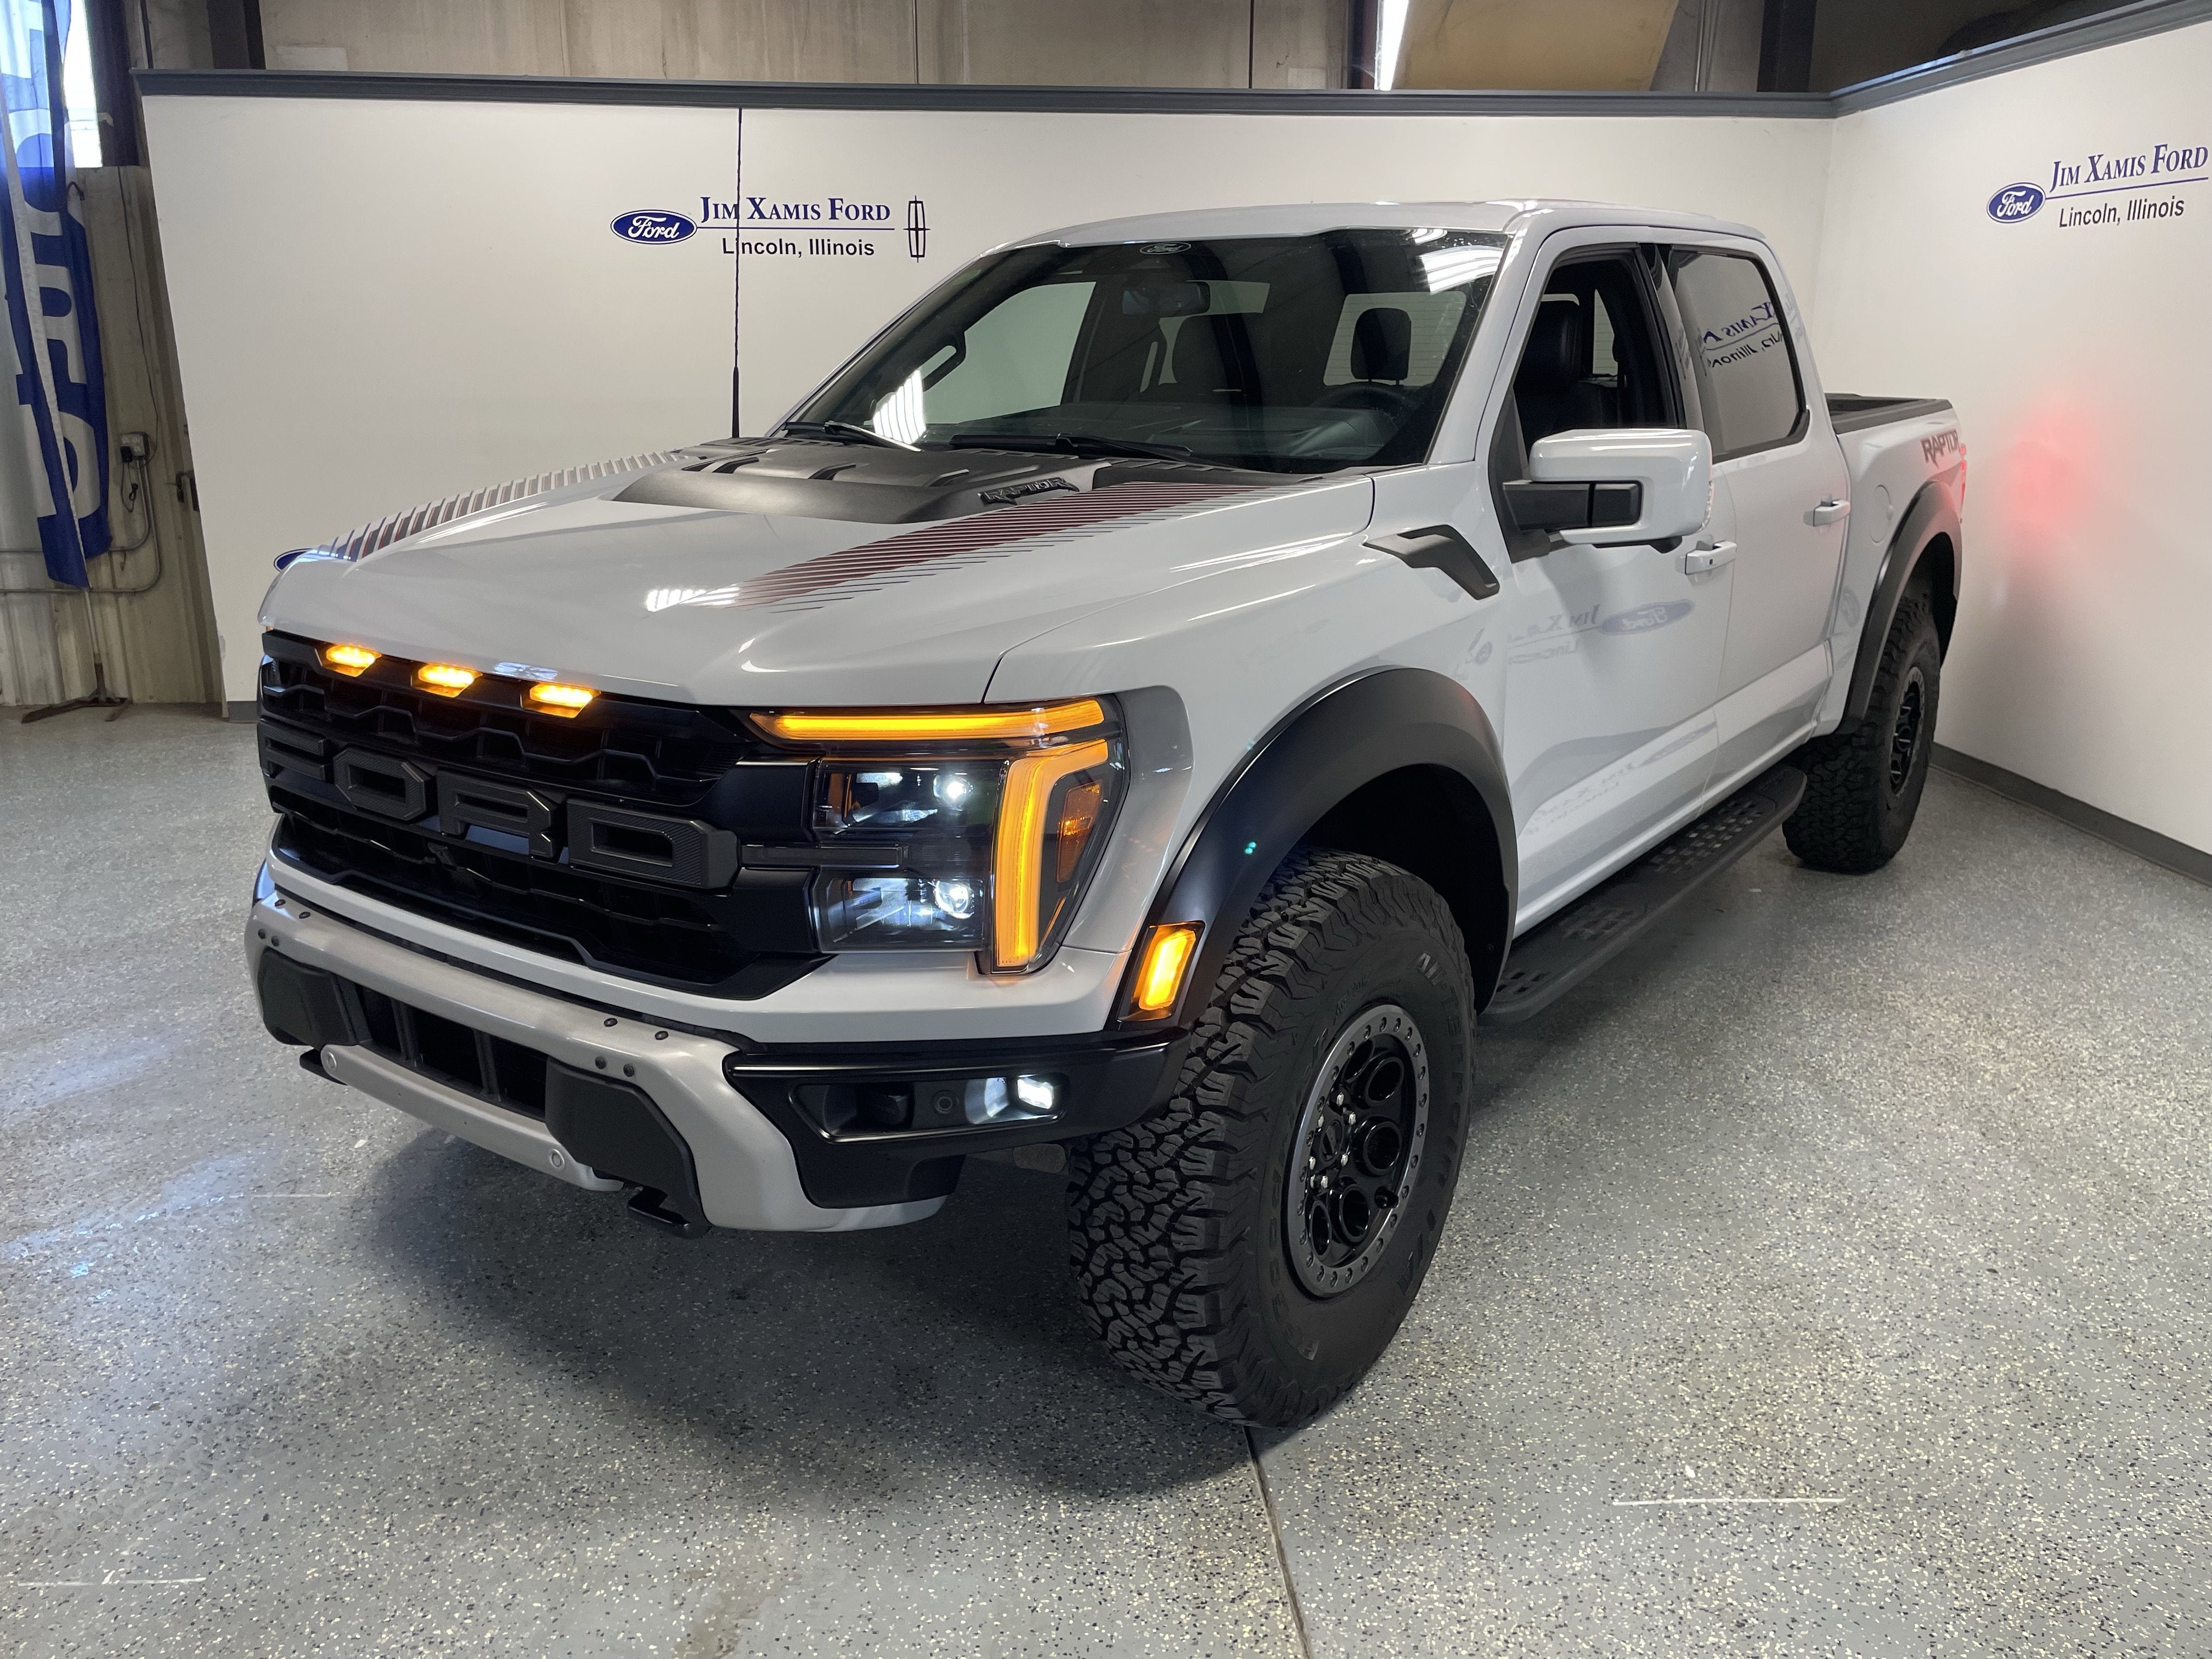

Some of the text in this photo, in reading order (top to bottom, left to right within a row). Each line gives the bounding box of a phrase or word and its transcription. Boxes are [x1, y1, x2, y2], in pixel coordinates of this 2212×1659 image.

[2049, 143, 2209, 193] JIM XAMIS FORD
[746, 197, 821, 221] XAMIS
[828, 198, 891, 221] FORD
[2059, 195, 2185, 228] Lincoln, Illinois
[722, 238, 875, 258] Lincoln, Illinois
[1921, 430, 1961, 470] RAPTOR
[977, 477, 1080, 505] RAPTOR
[258, 715, 738, 890] FORD
